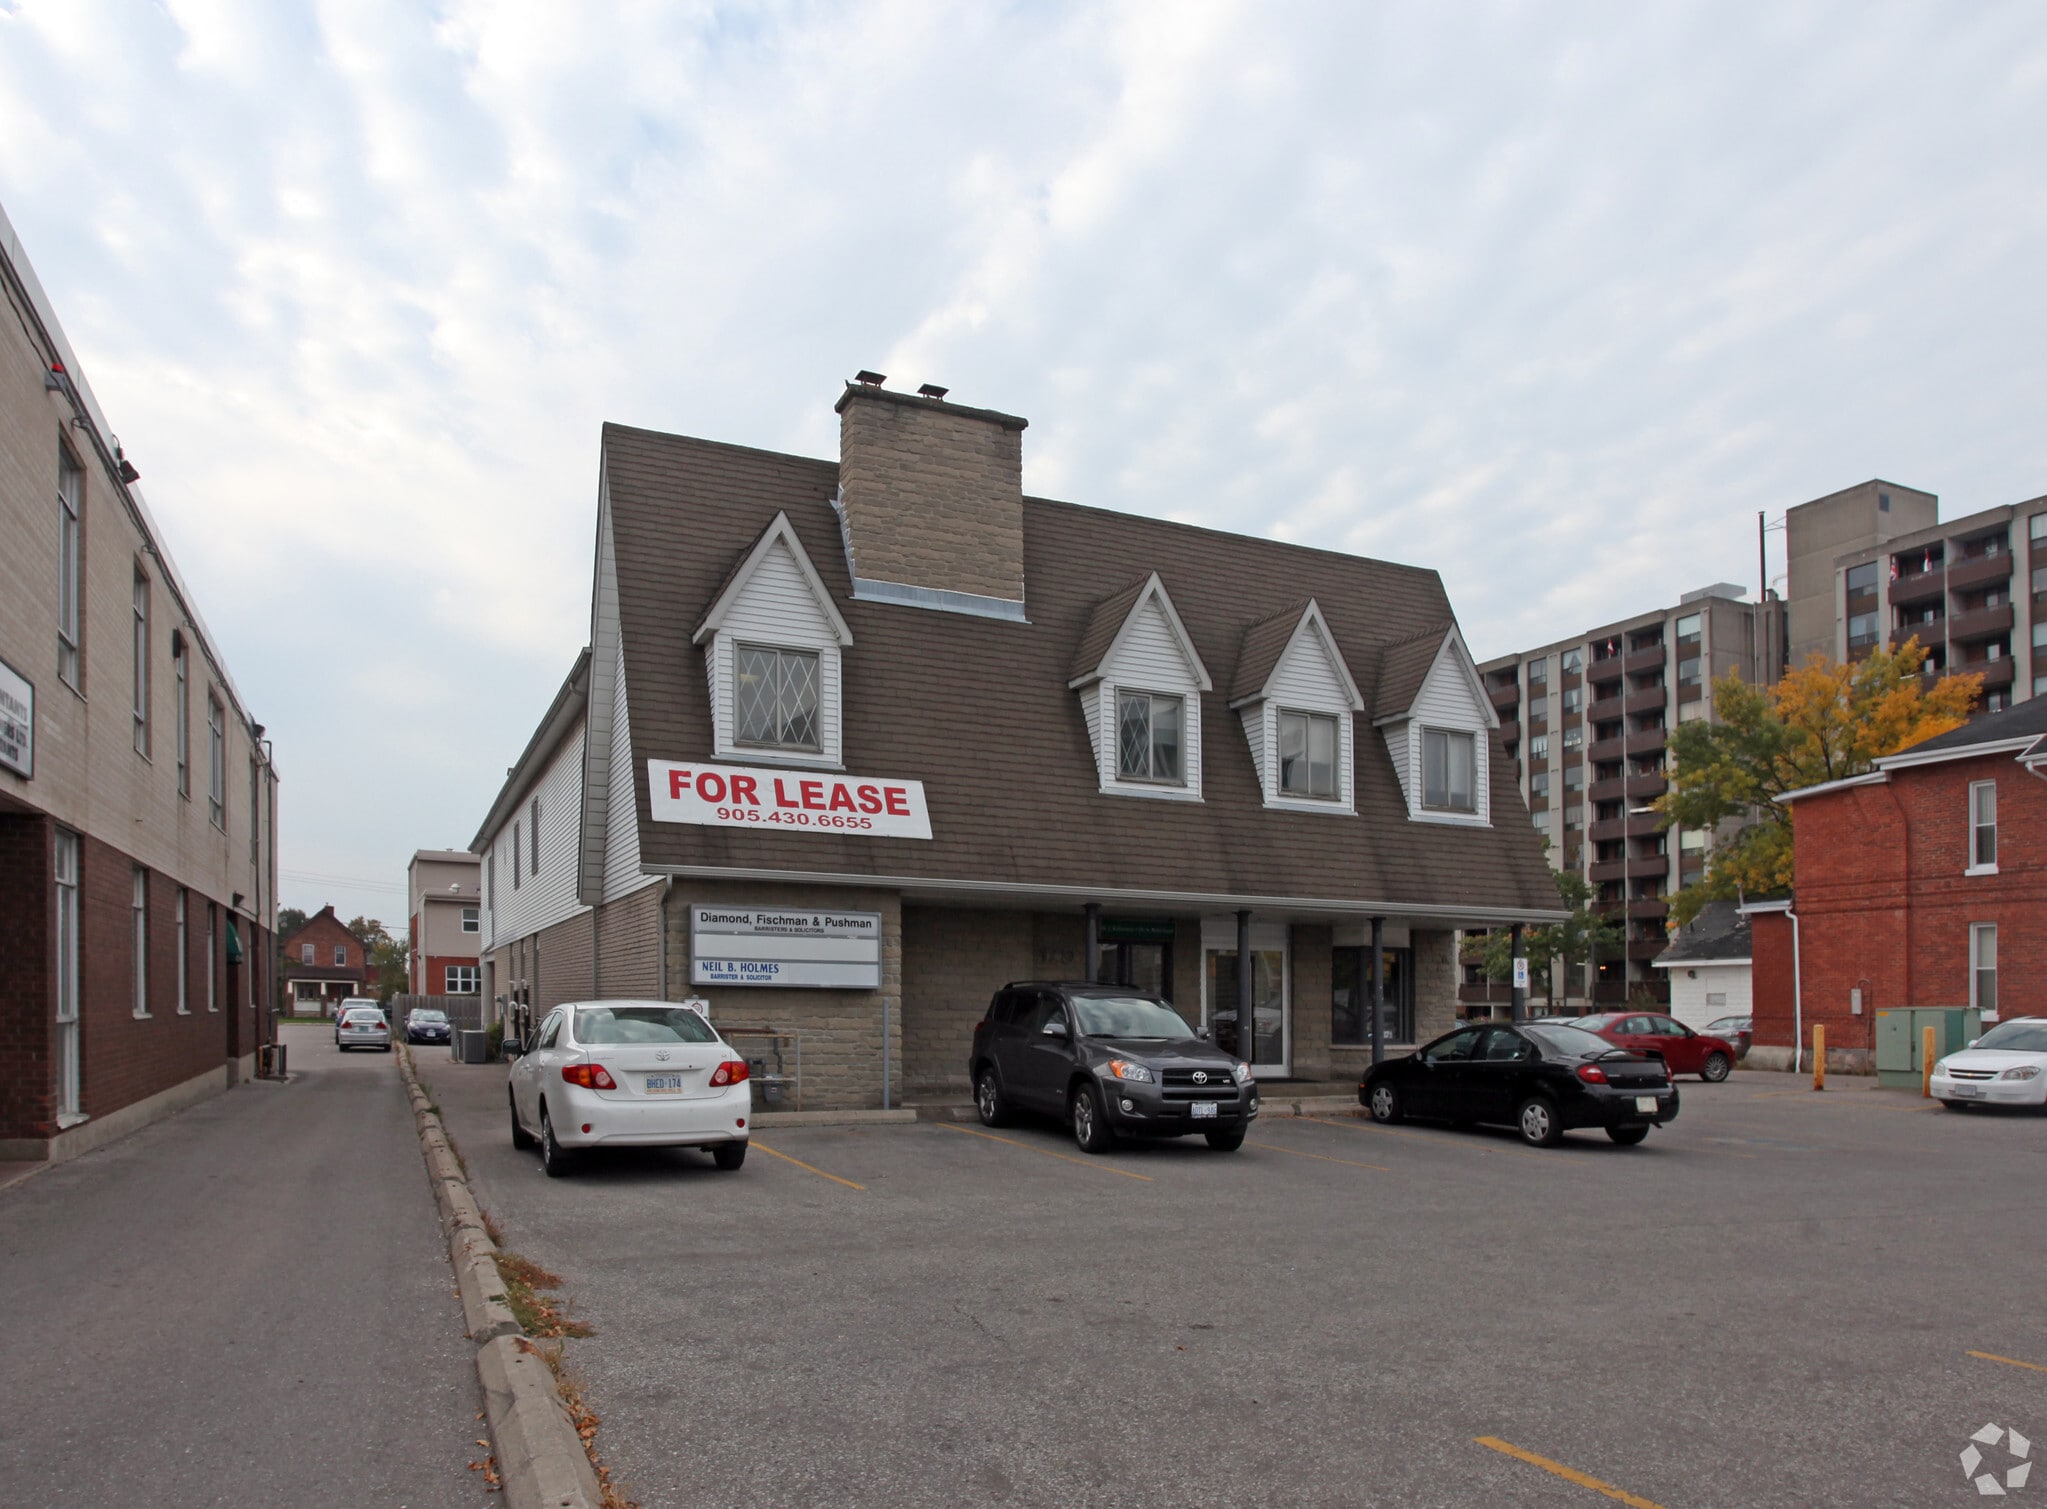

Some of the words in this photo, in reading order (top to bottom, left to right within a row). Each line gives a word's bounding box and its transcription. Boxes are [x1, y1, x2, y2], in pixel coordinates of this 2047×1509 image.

[669, 769, 761, 806] FOR
[774, 779, 911, 817] LEASE
[717, 807, 873, 829] 905.430.6655
[700, 912, 752, 926] Diamond,
[757, 914, 808, 926] Fischman
[812, 916, 820, 927] &
[825, 917, 872, 928] Pushman
[702, 961, 723, 972] NEIL
[727, 962, 736, 972] B.
[740, 962, 779, 974] HOLMES
